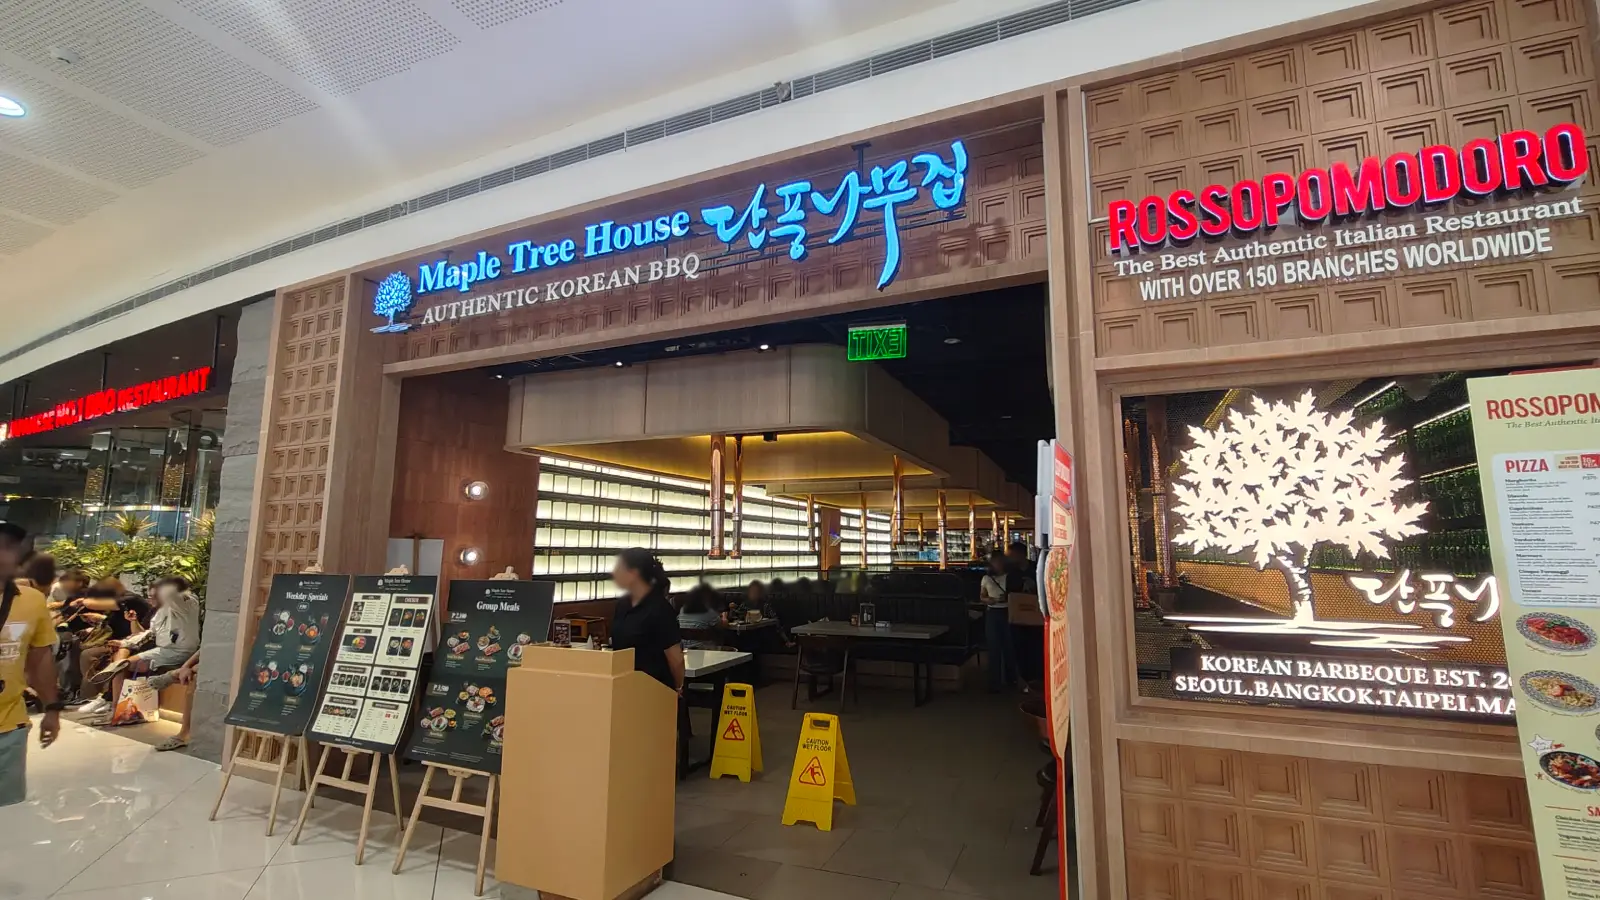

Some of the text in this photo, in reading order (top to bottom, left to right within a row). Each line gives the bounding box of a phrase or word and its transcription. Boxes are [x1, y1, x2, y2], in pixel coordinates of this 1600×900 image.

[1108, 122, 1589, 251] ROSSOPOMODORO
[417, 209, 691, 293] Maple Tree House
[1114, 196, 1585, 277] The Best Authentic Italian Restaurant
[1140, 227, 1553, 300] WITH OVER 150 BRANCHES WORLDWIDE
[421, 252, 702, 325] AUTHENTIC KOREAN BBQ
[118, 366, 212, 411] RESTAURANT
[1525, 420, 1542, 428] Best
[1544, 418, 1588, 427] Authentic
[1505, 459, 1549, 473] PIZZA
[286, 591, 329, 602] Weekday Specials
[476, 601, 520, 612] Group Meals
[1200, 655, 1292, 677] KOREAN
[1297, 660, 1430, 686] BARBEQUE
[1434, 667, 1487, 689] EST.
[806, 737, 829, 746] CAUTION
[813, 744, 832, 752] FLOOR
